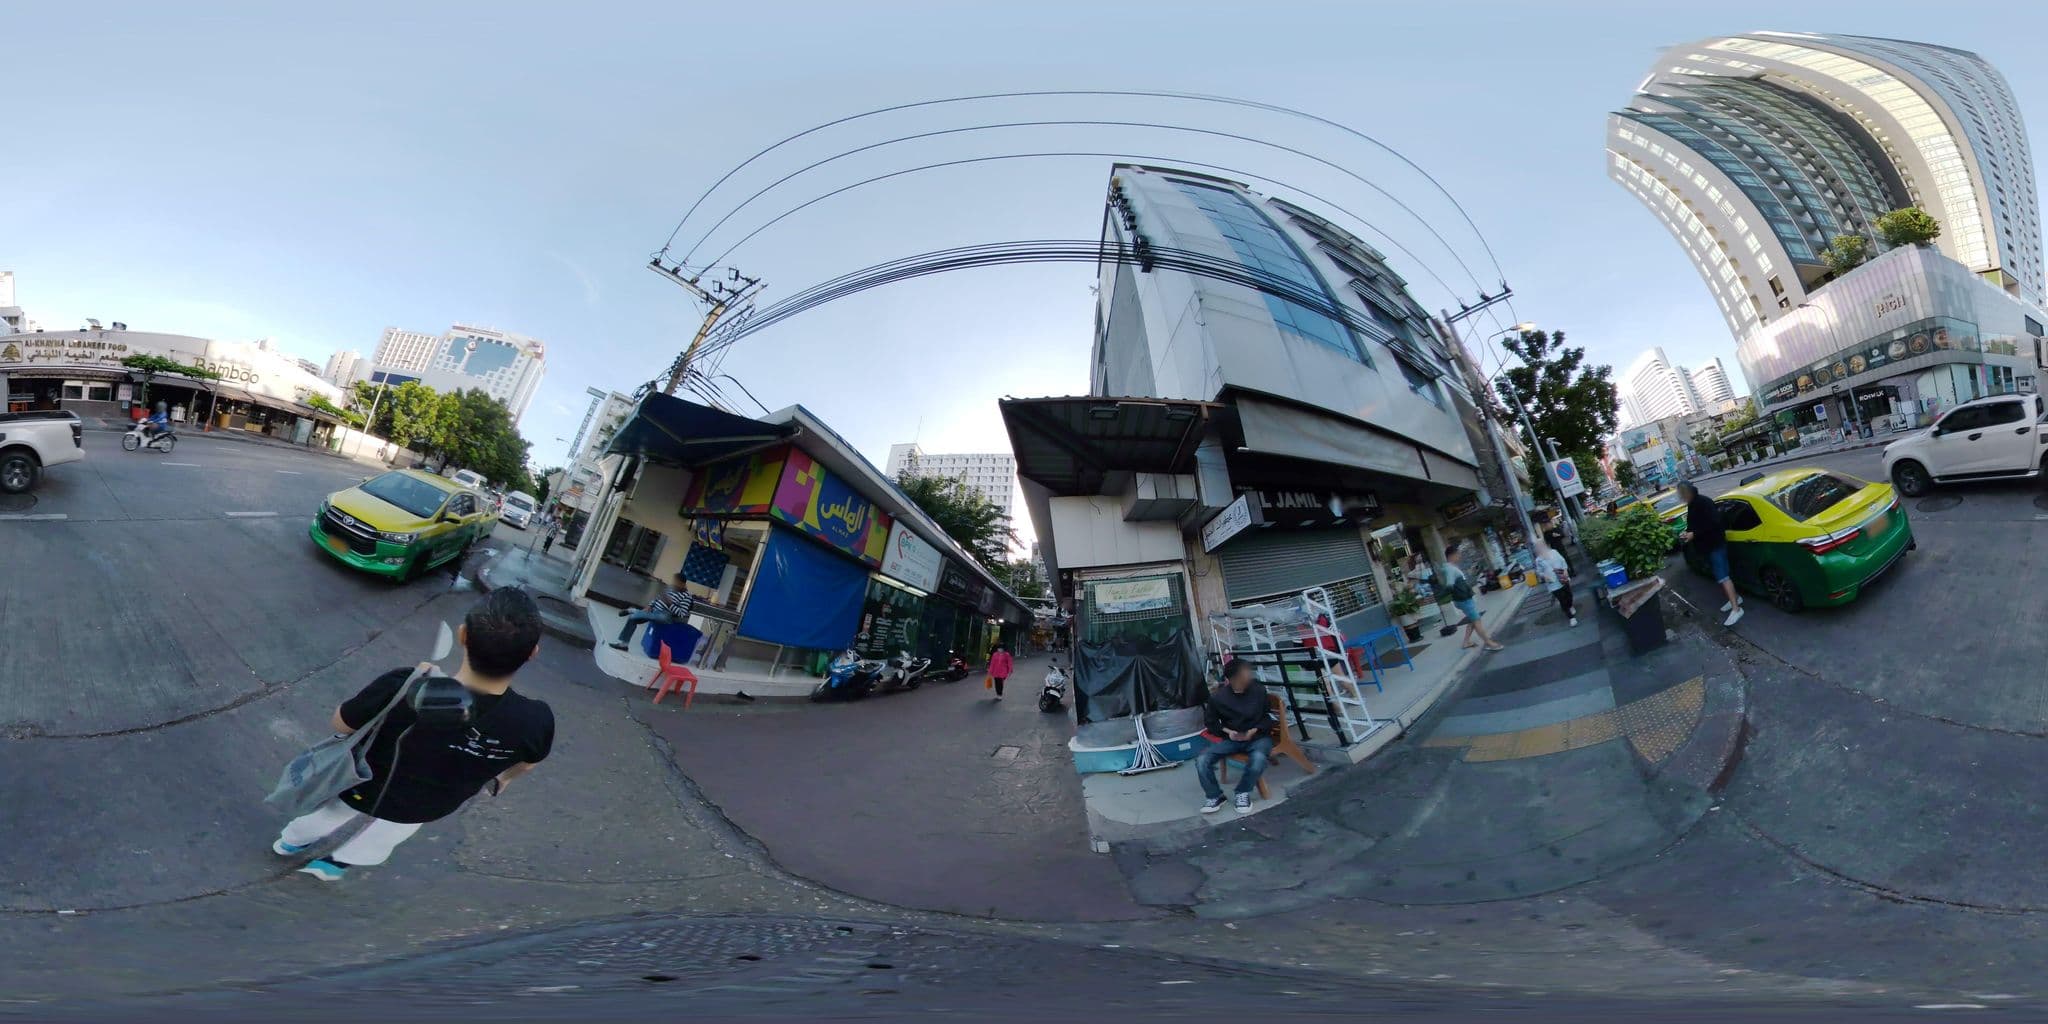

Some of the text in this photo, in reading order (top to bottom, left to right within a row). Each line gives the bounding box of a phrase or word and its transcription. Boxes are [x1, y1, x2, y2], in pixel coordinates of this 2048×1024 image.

[107, 343, 128, 352] FOOD
[193, 356, 260, 384] Bamboo
[1275, 491, 1323, 509] JAMIL
[821, 496, 866, 534] الماس
